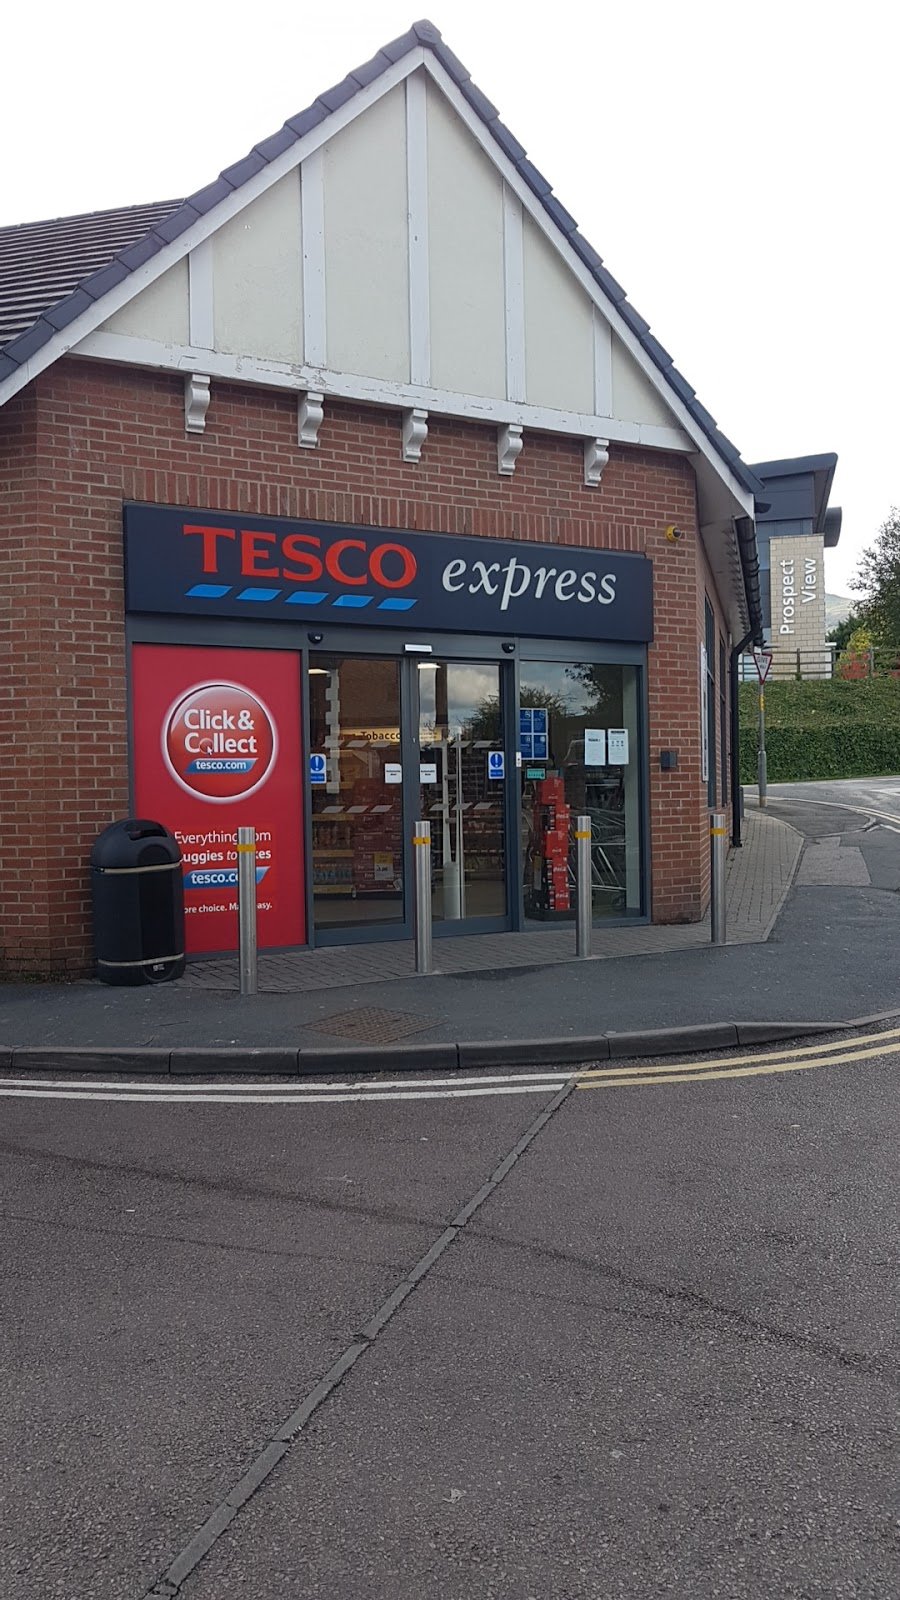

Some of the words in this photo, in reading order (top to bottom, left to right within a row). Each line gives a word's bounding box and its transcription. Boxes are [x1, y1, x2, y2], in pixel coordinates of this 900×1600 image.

[183, 524, 418, 589] TESCO
[442, 557, 617, 611] express
[801, 558, 817, 604] View
[780, 559, 797, 636] Prospect
[184, 732, 258, 754] Collect
[196, 761, 247, 770] tesco.com
[183, 850, 224, 865] uggies
[184, 906, 197, 914] ore
[198, 903, 227, 912] choice.
[256, 902, 273, 911] asy.
